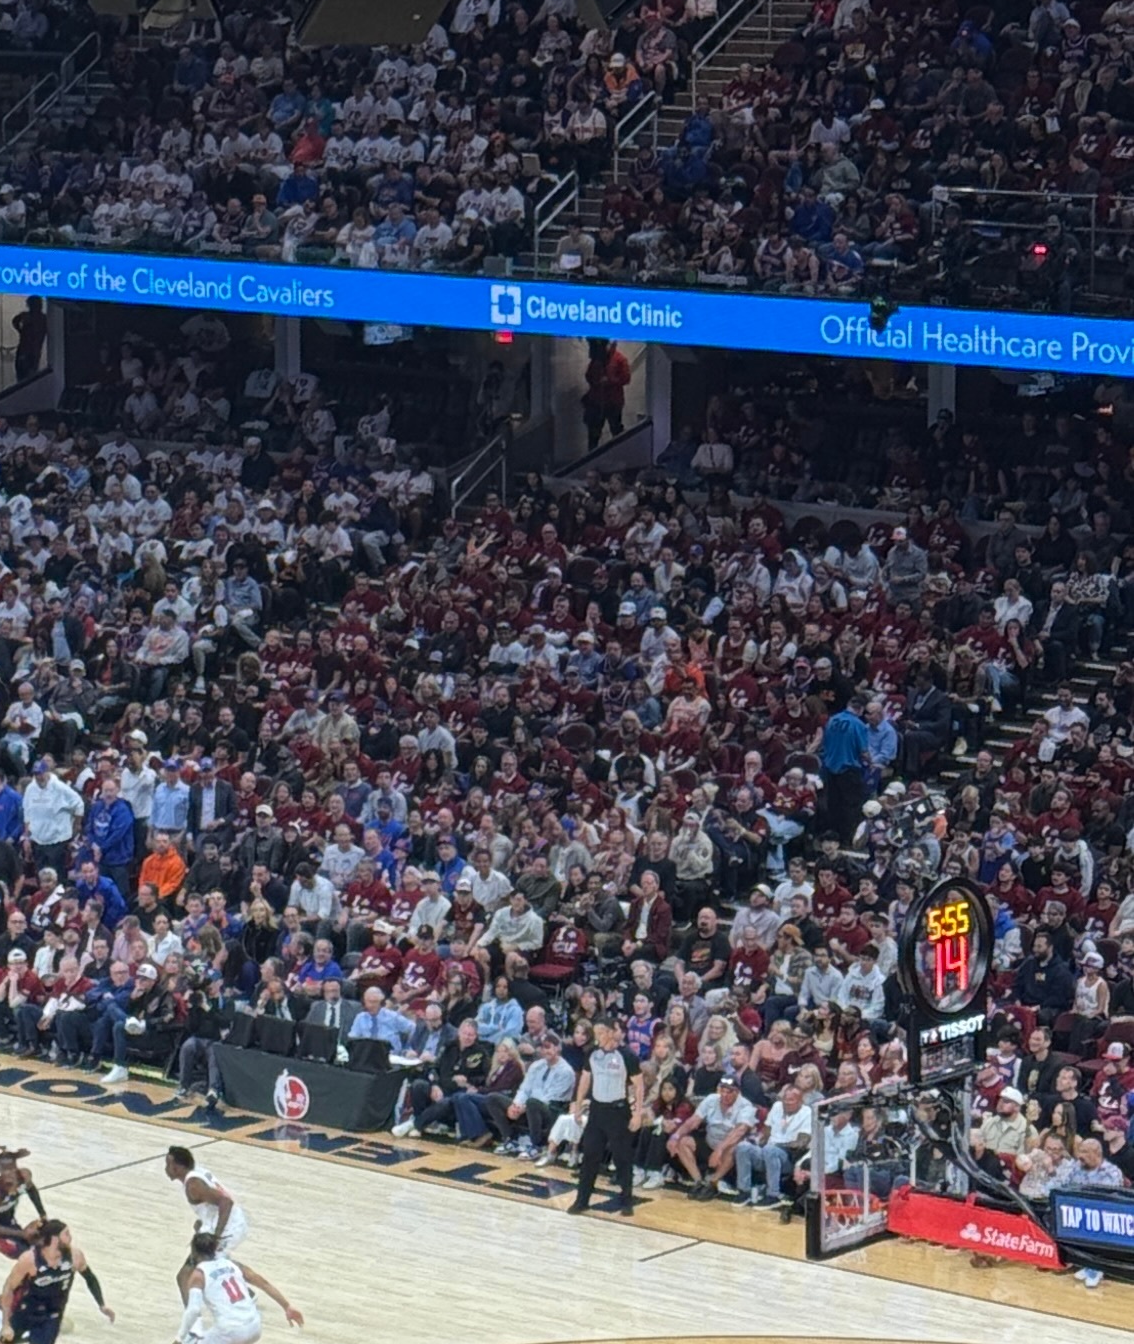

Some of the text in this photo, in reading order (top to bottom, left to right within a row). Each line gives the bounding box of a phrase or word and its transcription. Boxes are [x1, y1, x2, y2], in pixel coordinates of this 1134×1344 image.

[67, 264, 90, 290] of
[94, 265, 126, 293] the
[132, 267, 232, 301] Cleveland
[238, 275, 335, 308] Cavaliers
[527, 296, 682, 329] Cleveland Clinic
[922, 319, 1063, 360] Healthcare
[1072, 331, 1134, 367] Provi
[928, 902, 970, 941] 5:55
[935, 936, 967, 997] 14
[939, 1014, 986, 1042] TISSOT
[1060, 1202, 1134, 1237] TAP TO WATC
[221, 1276, 245, 1305] 11
